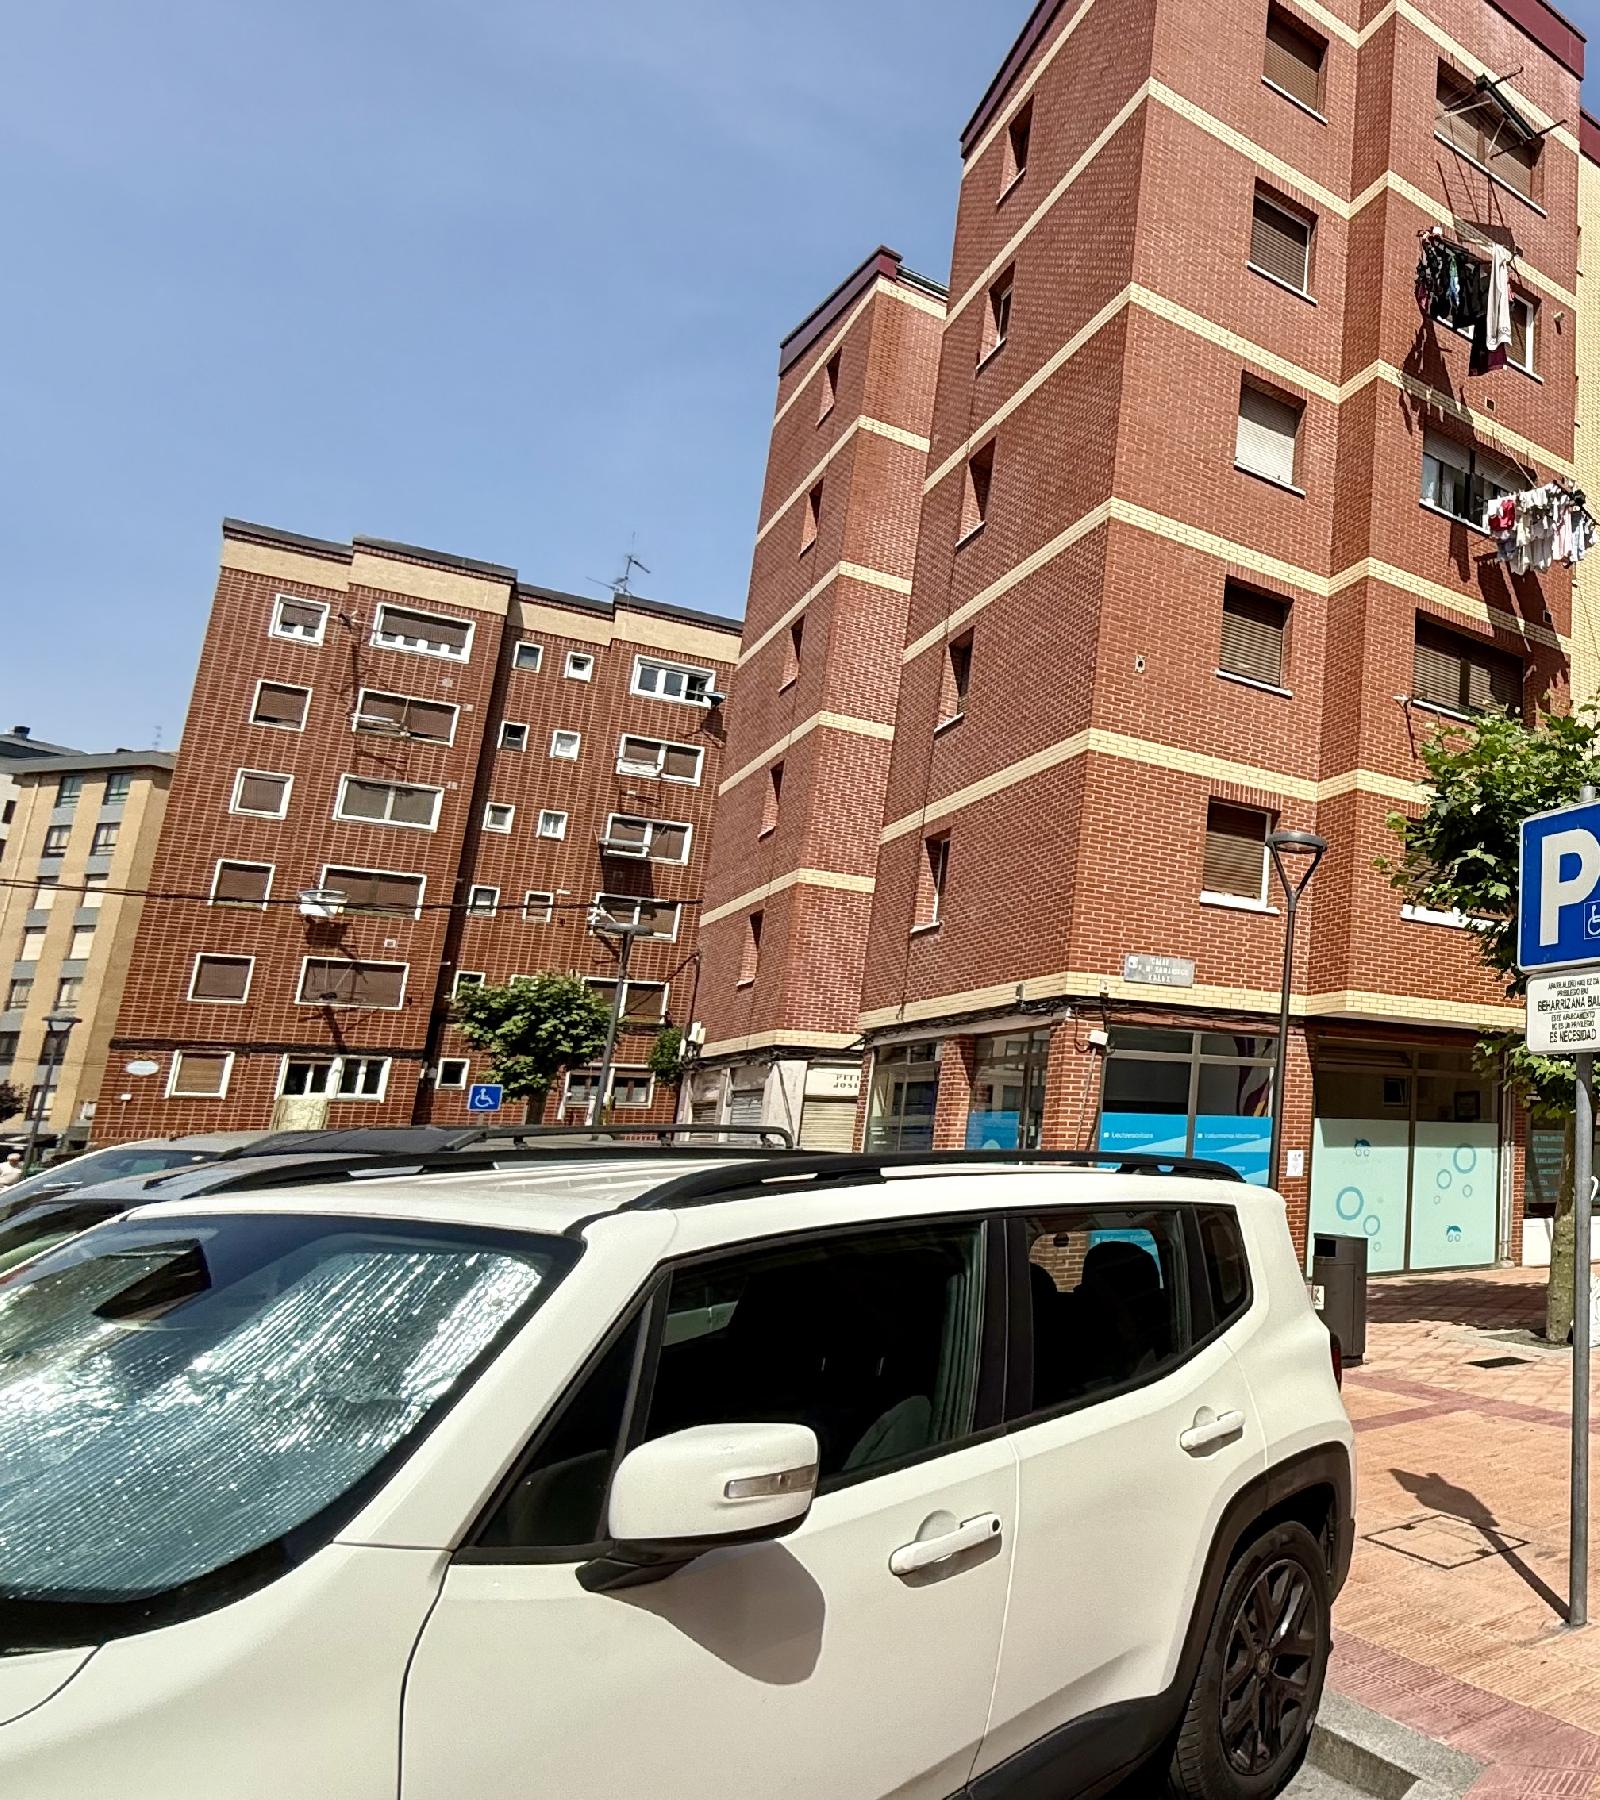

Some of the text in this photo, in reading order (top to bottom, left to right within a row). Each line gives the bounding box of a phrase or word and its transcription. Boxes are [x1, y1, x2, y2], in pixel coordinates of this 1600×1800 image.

[1537, 997, 1585, 1012] BEHARRIZANA
[1549, 1028, 1597, 1043] ES NECESIDAD
